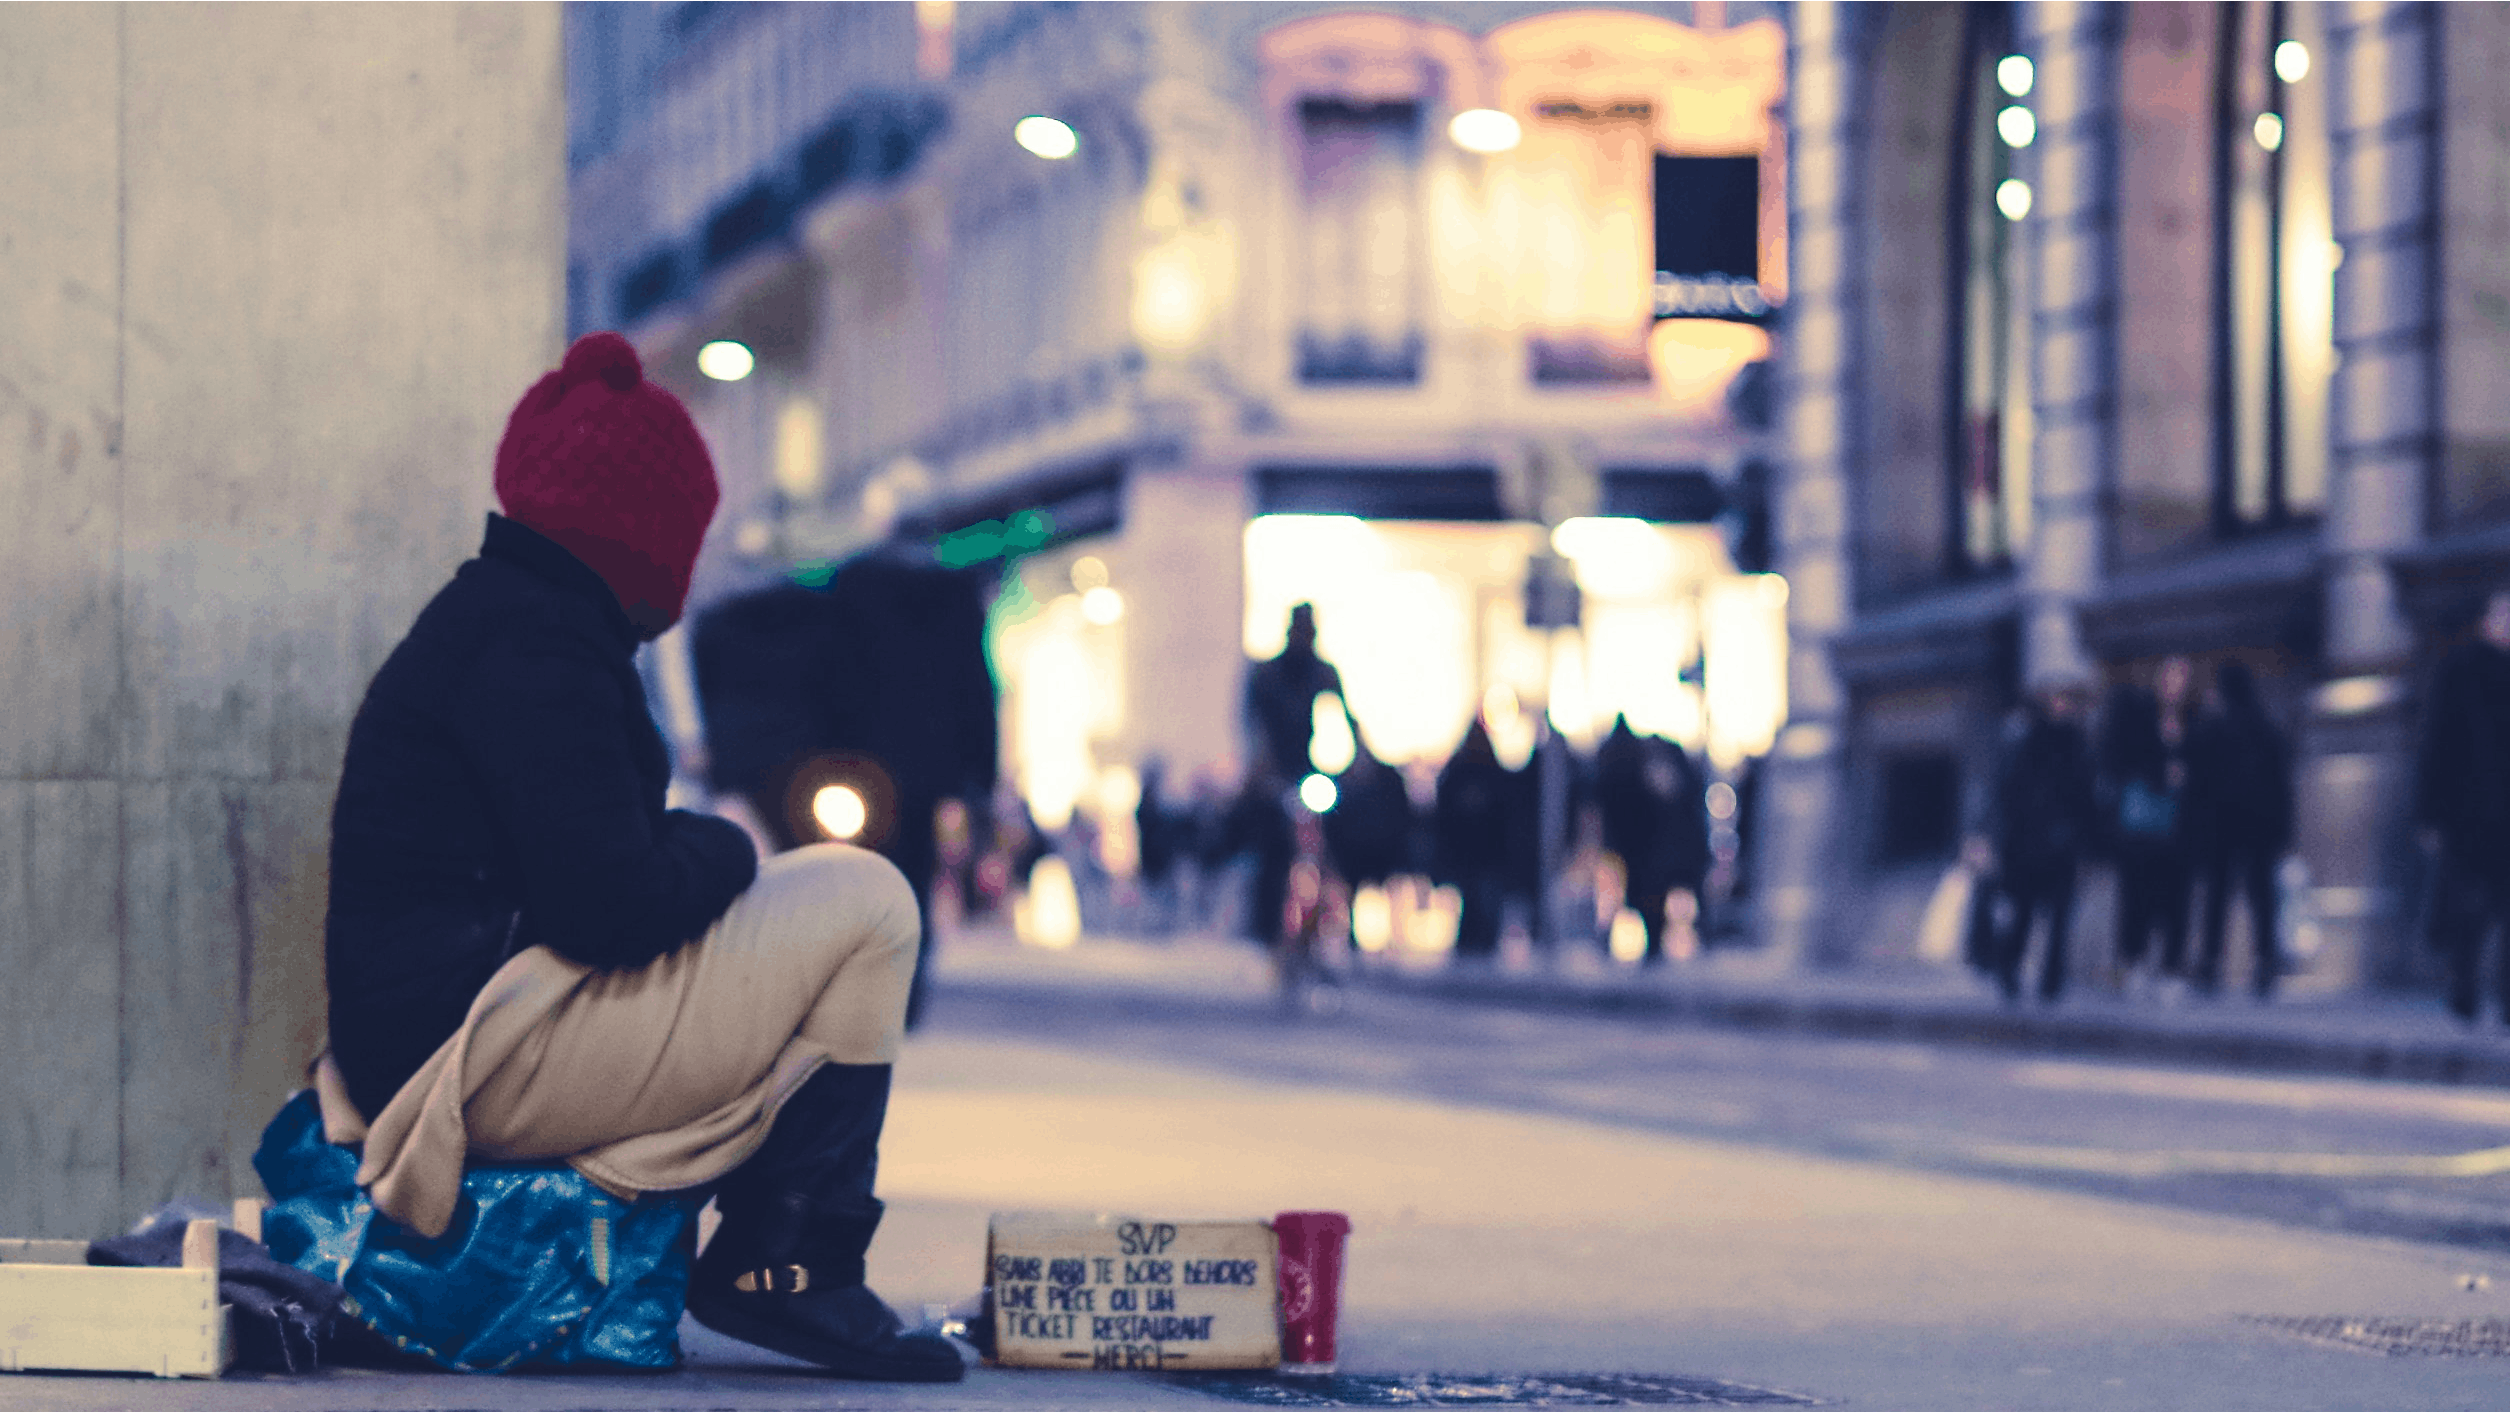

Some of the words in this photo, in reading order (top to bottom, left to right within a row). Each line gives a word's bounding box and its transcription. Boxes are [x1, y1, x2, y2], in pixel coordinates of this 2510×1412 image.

[1117, 1221, 1176, 1256] SVP
[1000, 1284, 1037, 1310] UNE
[1110, 1288, 1137, 1312] OU
[1007, 1311, 1077, 1340] TICKET
[1092, 1315, 1214, 1342] RESTAURANT
